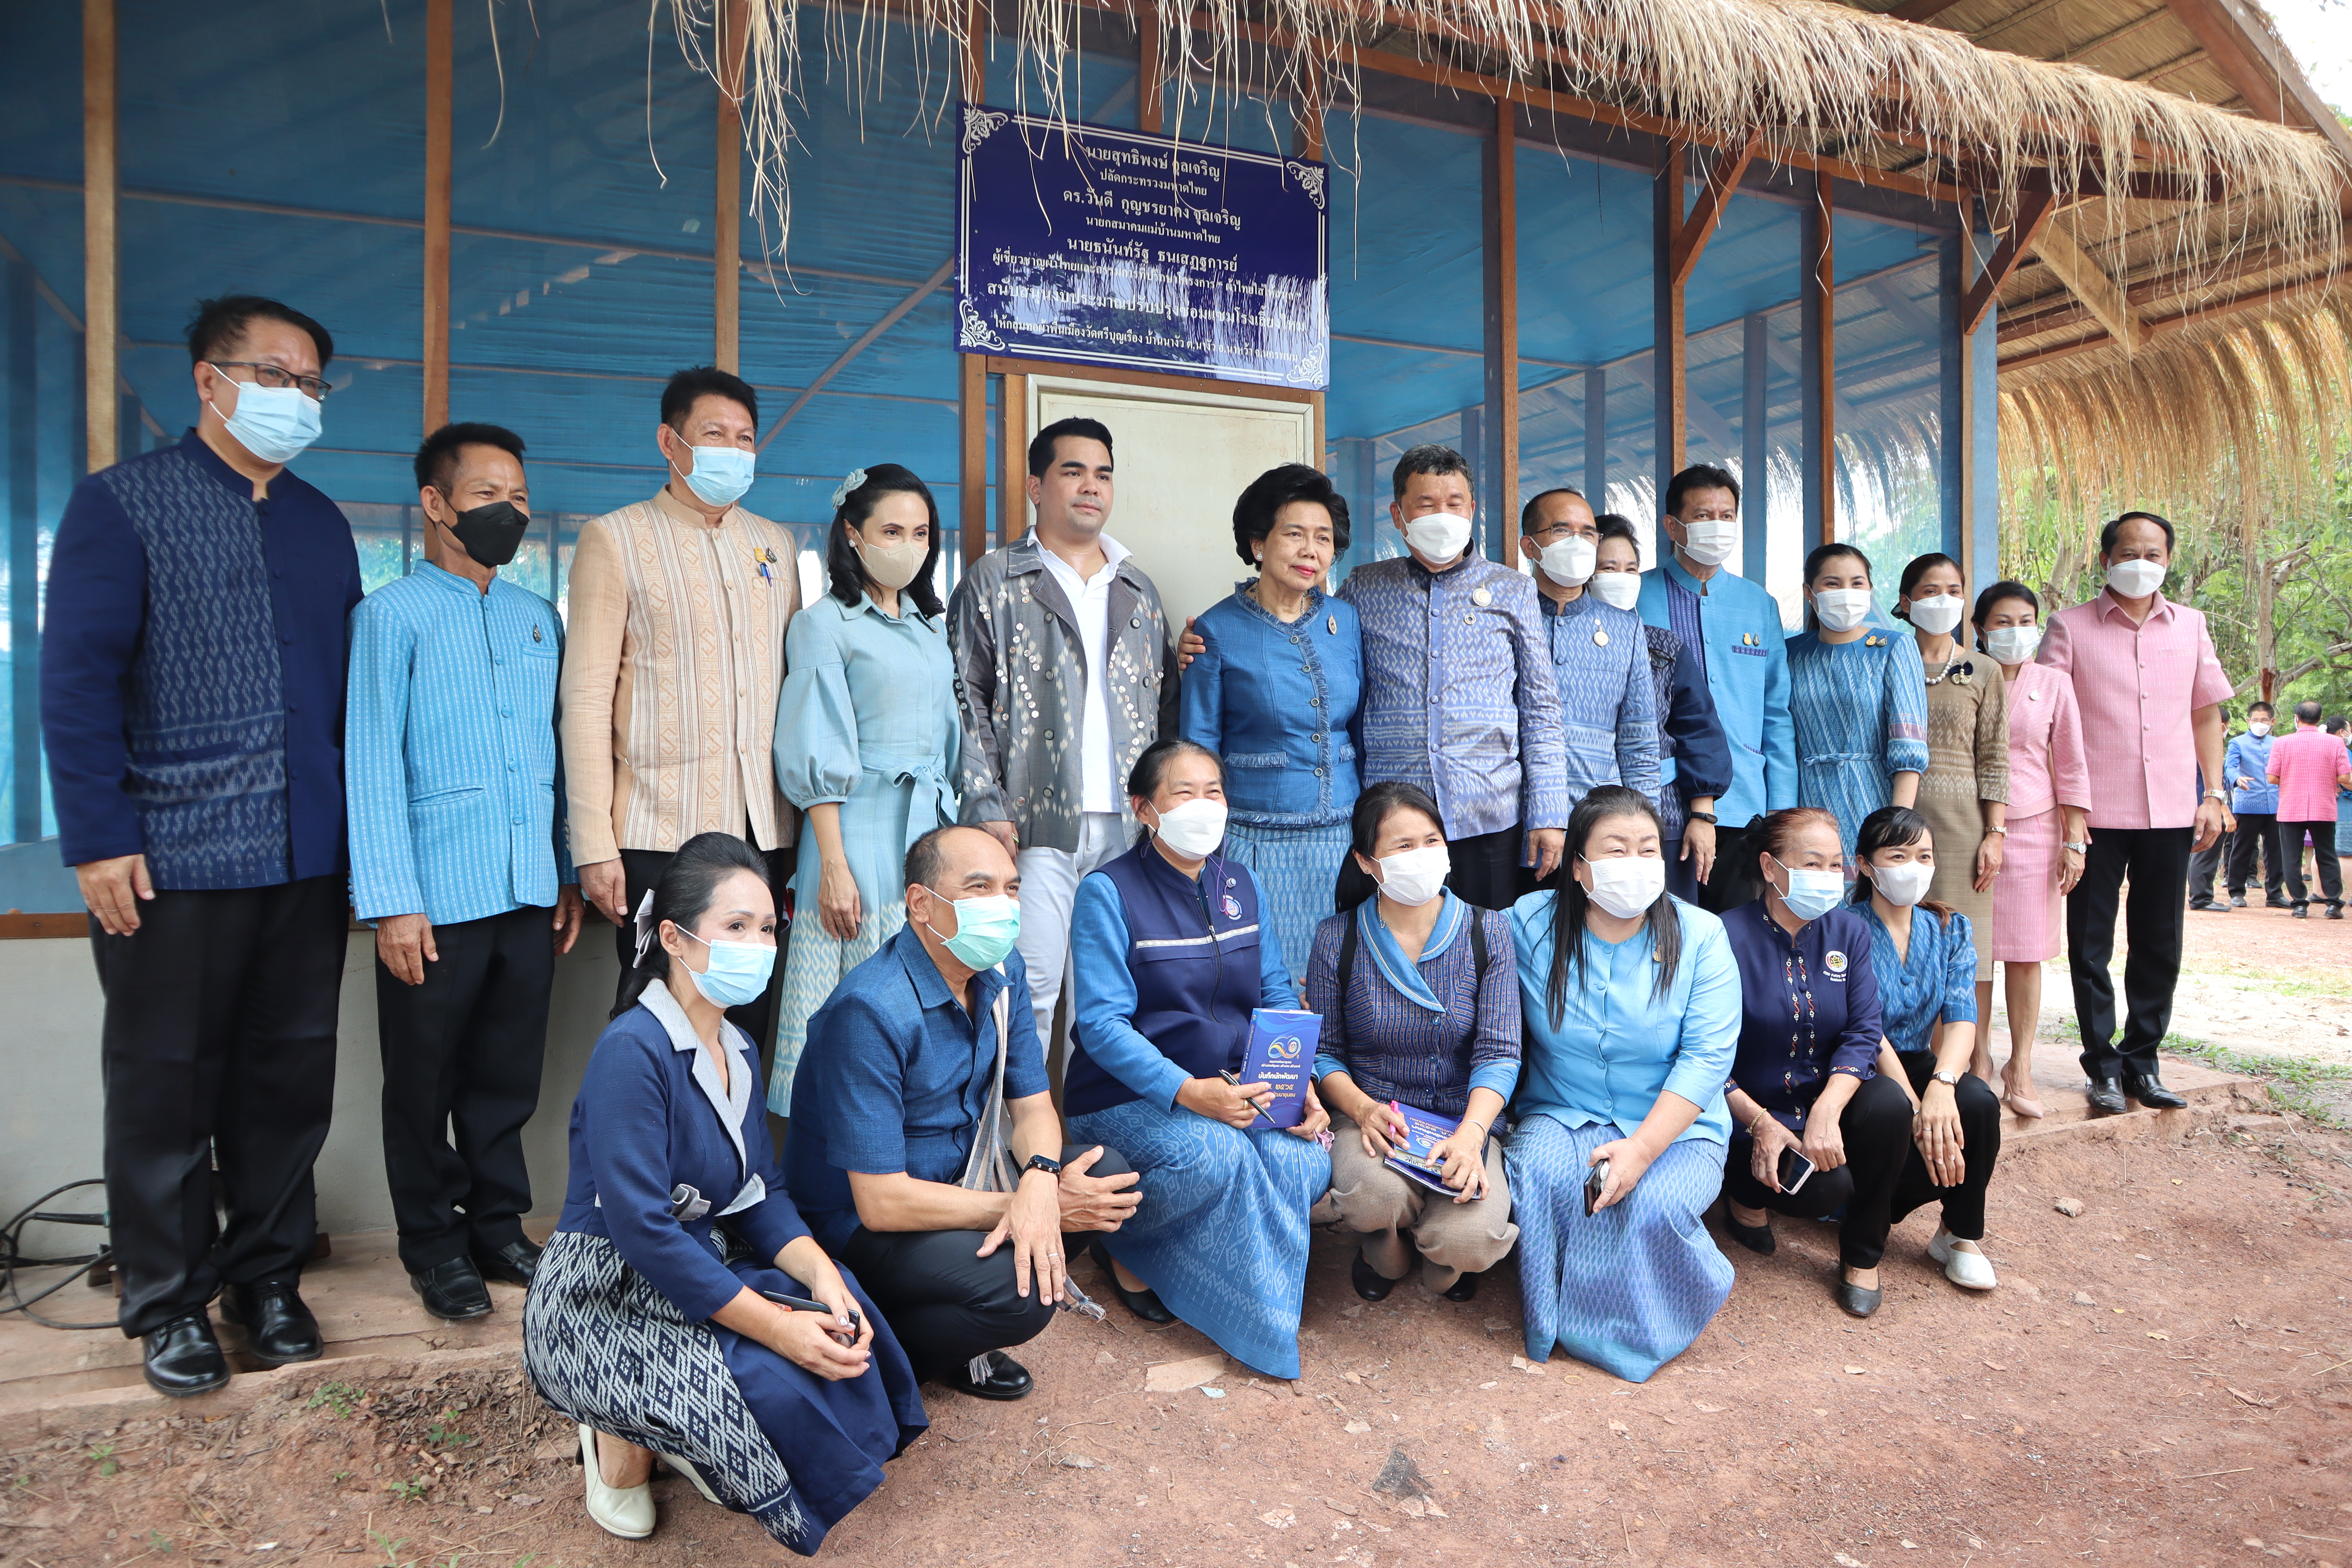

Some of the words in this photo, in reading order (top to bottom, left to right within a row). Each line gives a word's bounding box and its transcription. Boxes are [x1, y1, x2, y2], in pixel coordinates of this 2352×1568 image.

[1086, 146, 1168, 169] นายสุทธิพงษ์
[1100, 168, 1207, 196] ปลัดกระทรวงมหาดไทย
[1063, 187, 1113, 207] ดร.วันดี
[1122, 199, 1189, 219] กุญชรยาคง
[1193, 208, 1241, 230] จุลเจริญ
[1085, 216, 1220, 243] นายกสมาคมแม่บ้านมหาดไทย
[1067, 237, 1149, 263] นายธนันท์รัฐ
[1158, 250, 1238, 272] ธนเสฏฐการย์
[987, 278, 1305, 332] สนับสนุนงบประมาณปรับปรุงซ่อมแซมโรงเลี้ยงไหม
[994, 314, 1142, 345] ให้กลุ่มทอผ้าพื้นเมืองวัดศรีบุญเรือง
[1145, 331, 1184, 348] บ้านนางัว
